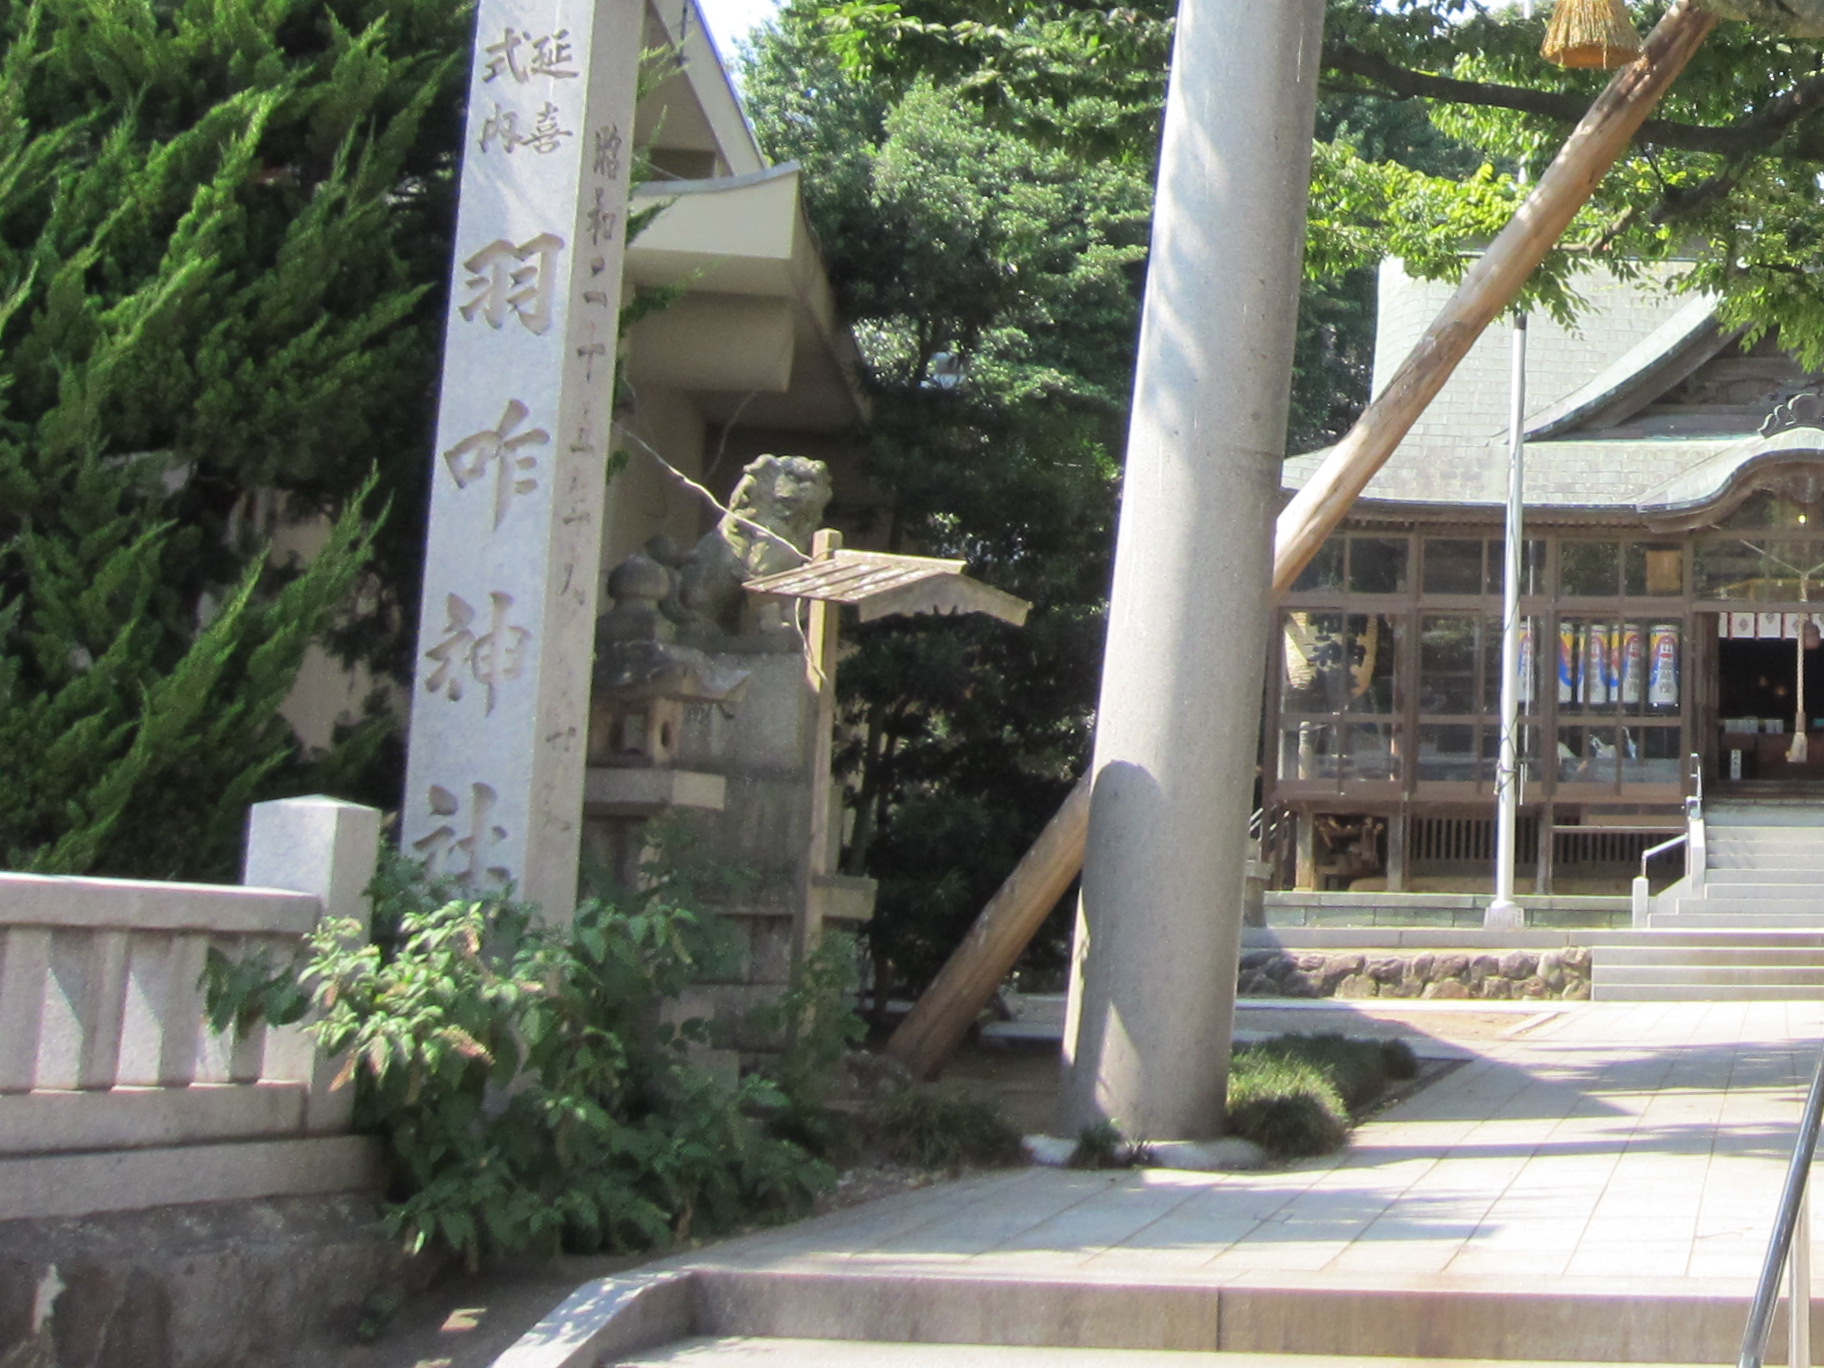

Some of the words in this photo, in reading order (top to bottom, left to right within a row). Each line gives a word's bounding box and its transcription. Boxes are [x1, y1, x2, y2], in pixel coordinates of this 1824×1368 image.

[477, 29, 532, 155] 式内
[532, 28, 580, 155] 延喜
[412, 231, 566, 890] 羽咋神社
